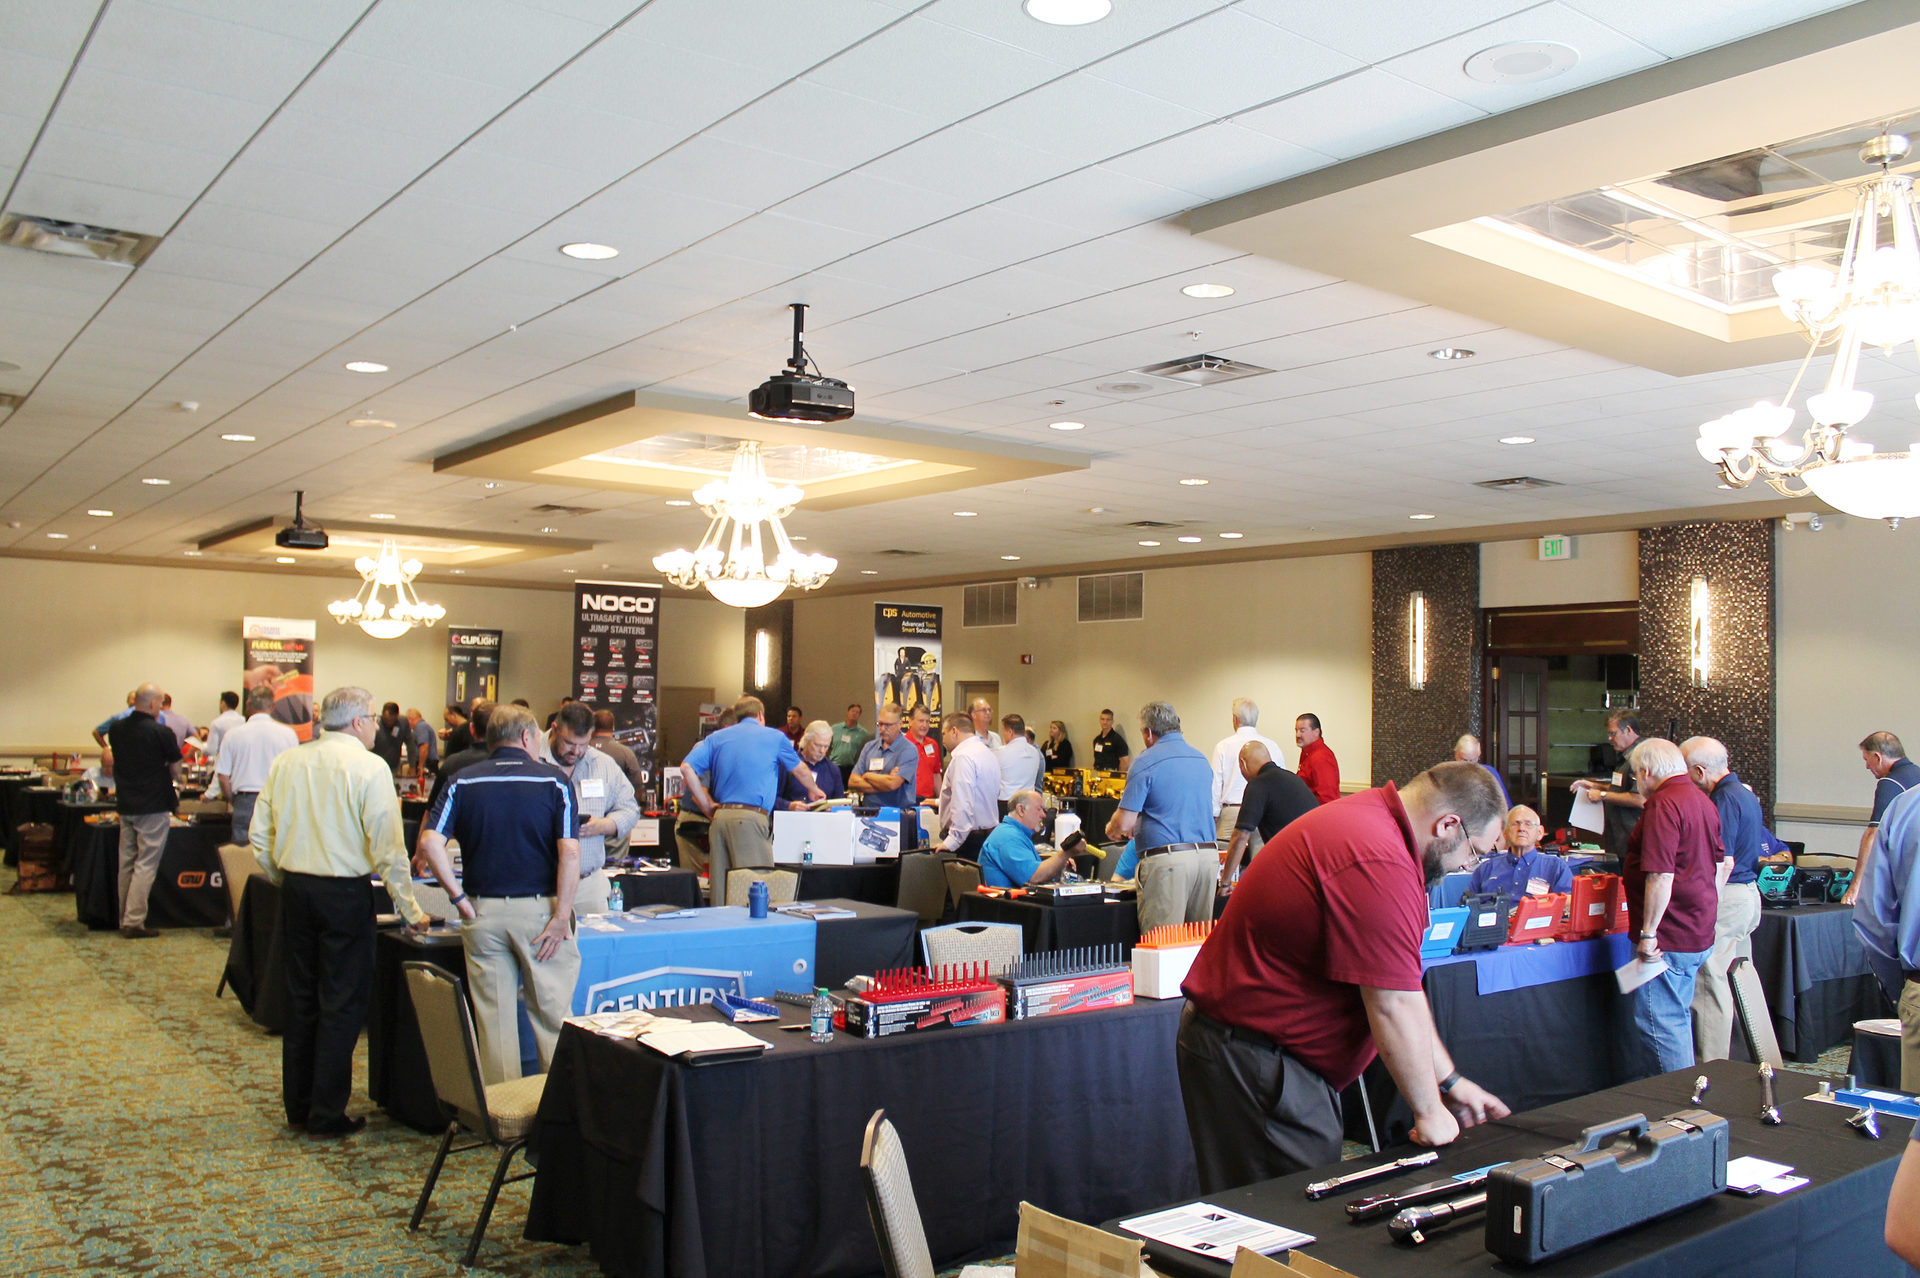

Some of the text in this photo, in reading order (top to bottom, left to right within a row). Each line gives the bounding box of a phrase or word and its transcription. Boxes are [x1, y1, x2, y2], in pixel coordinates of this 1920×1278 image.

[1544, 539, 1563, 557] EXIT
[582, 593, 655, 614] NOCO
[625, 615, 653, 625] LITHIUM
[901, 610, 936, 619] Automotive
[589, 624, 646, 635] JUMP STARTERS
[460, 635, 499, 646] CLIPLIGHT
